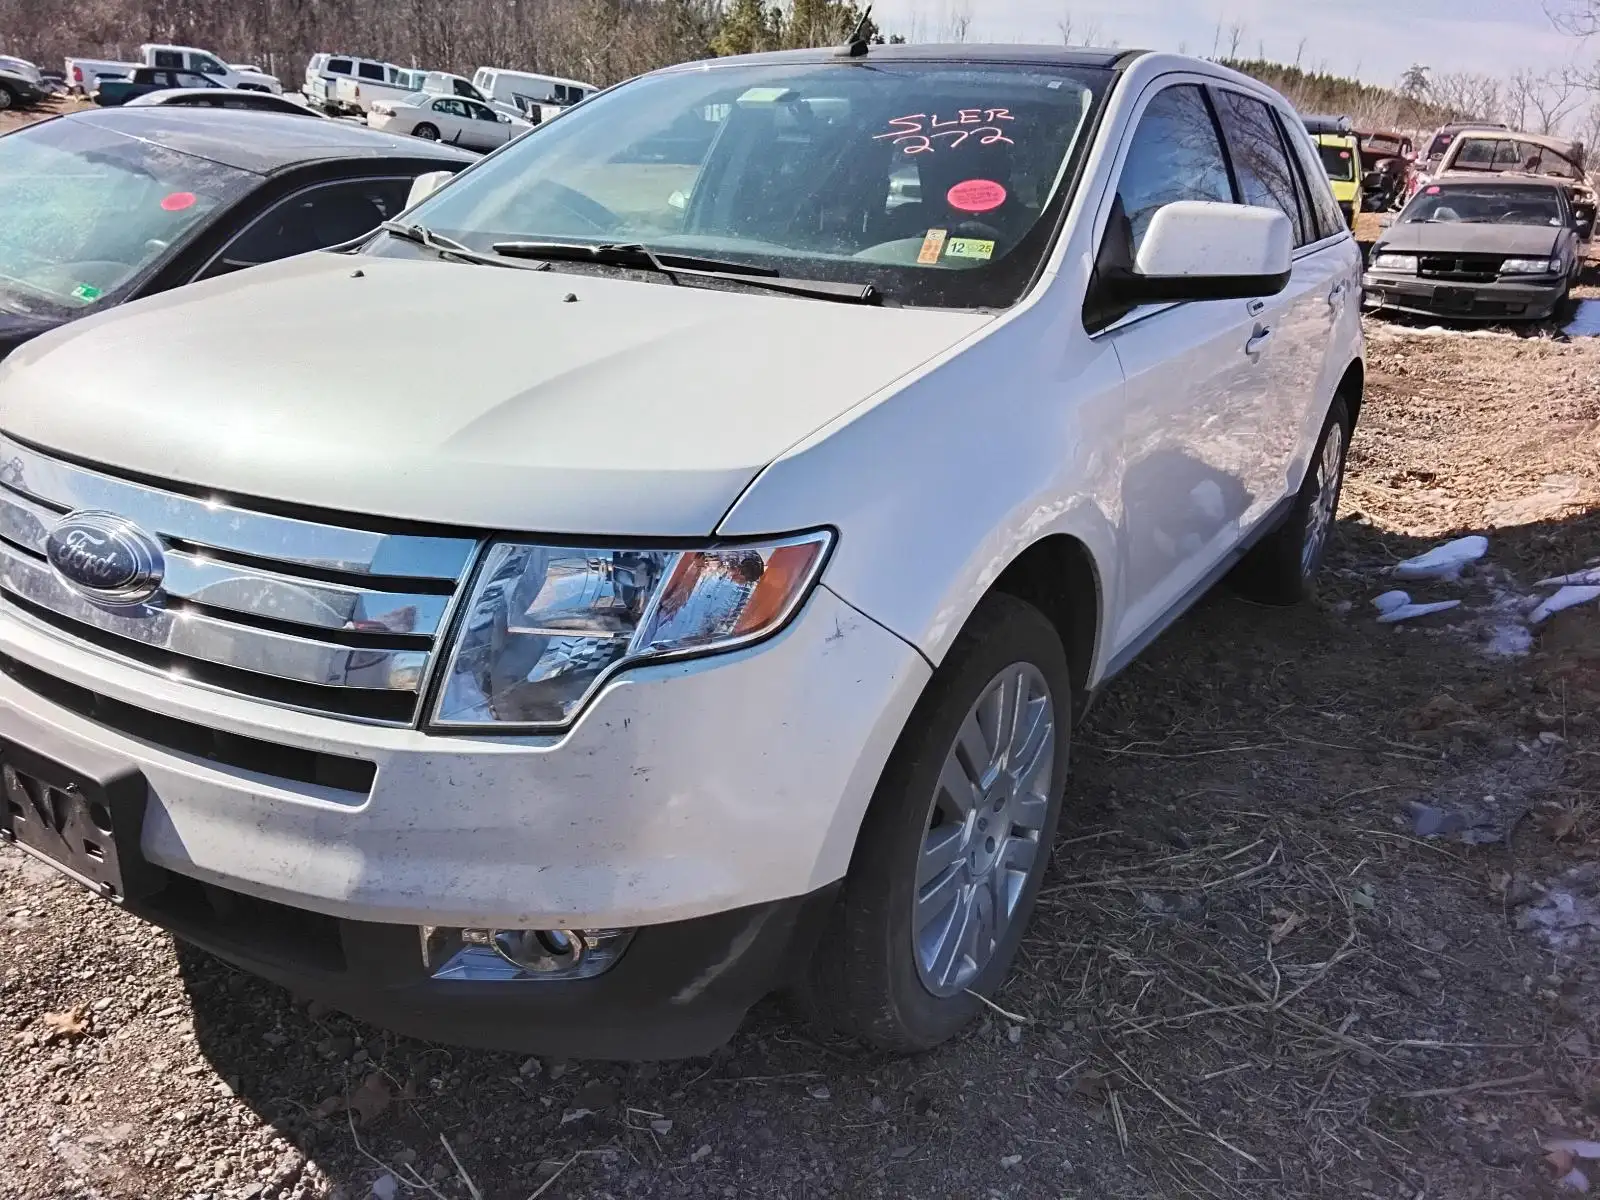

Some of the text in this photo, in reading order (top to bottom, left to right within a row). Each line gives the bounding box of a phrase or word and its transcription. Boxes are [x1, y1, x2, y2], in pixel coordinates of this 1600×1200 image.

[893, 126, 1014, 154] 272
[951, 242, 991, 253] 12 25
[58, 529, 118, 577] Ford
